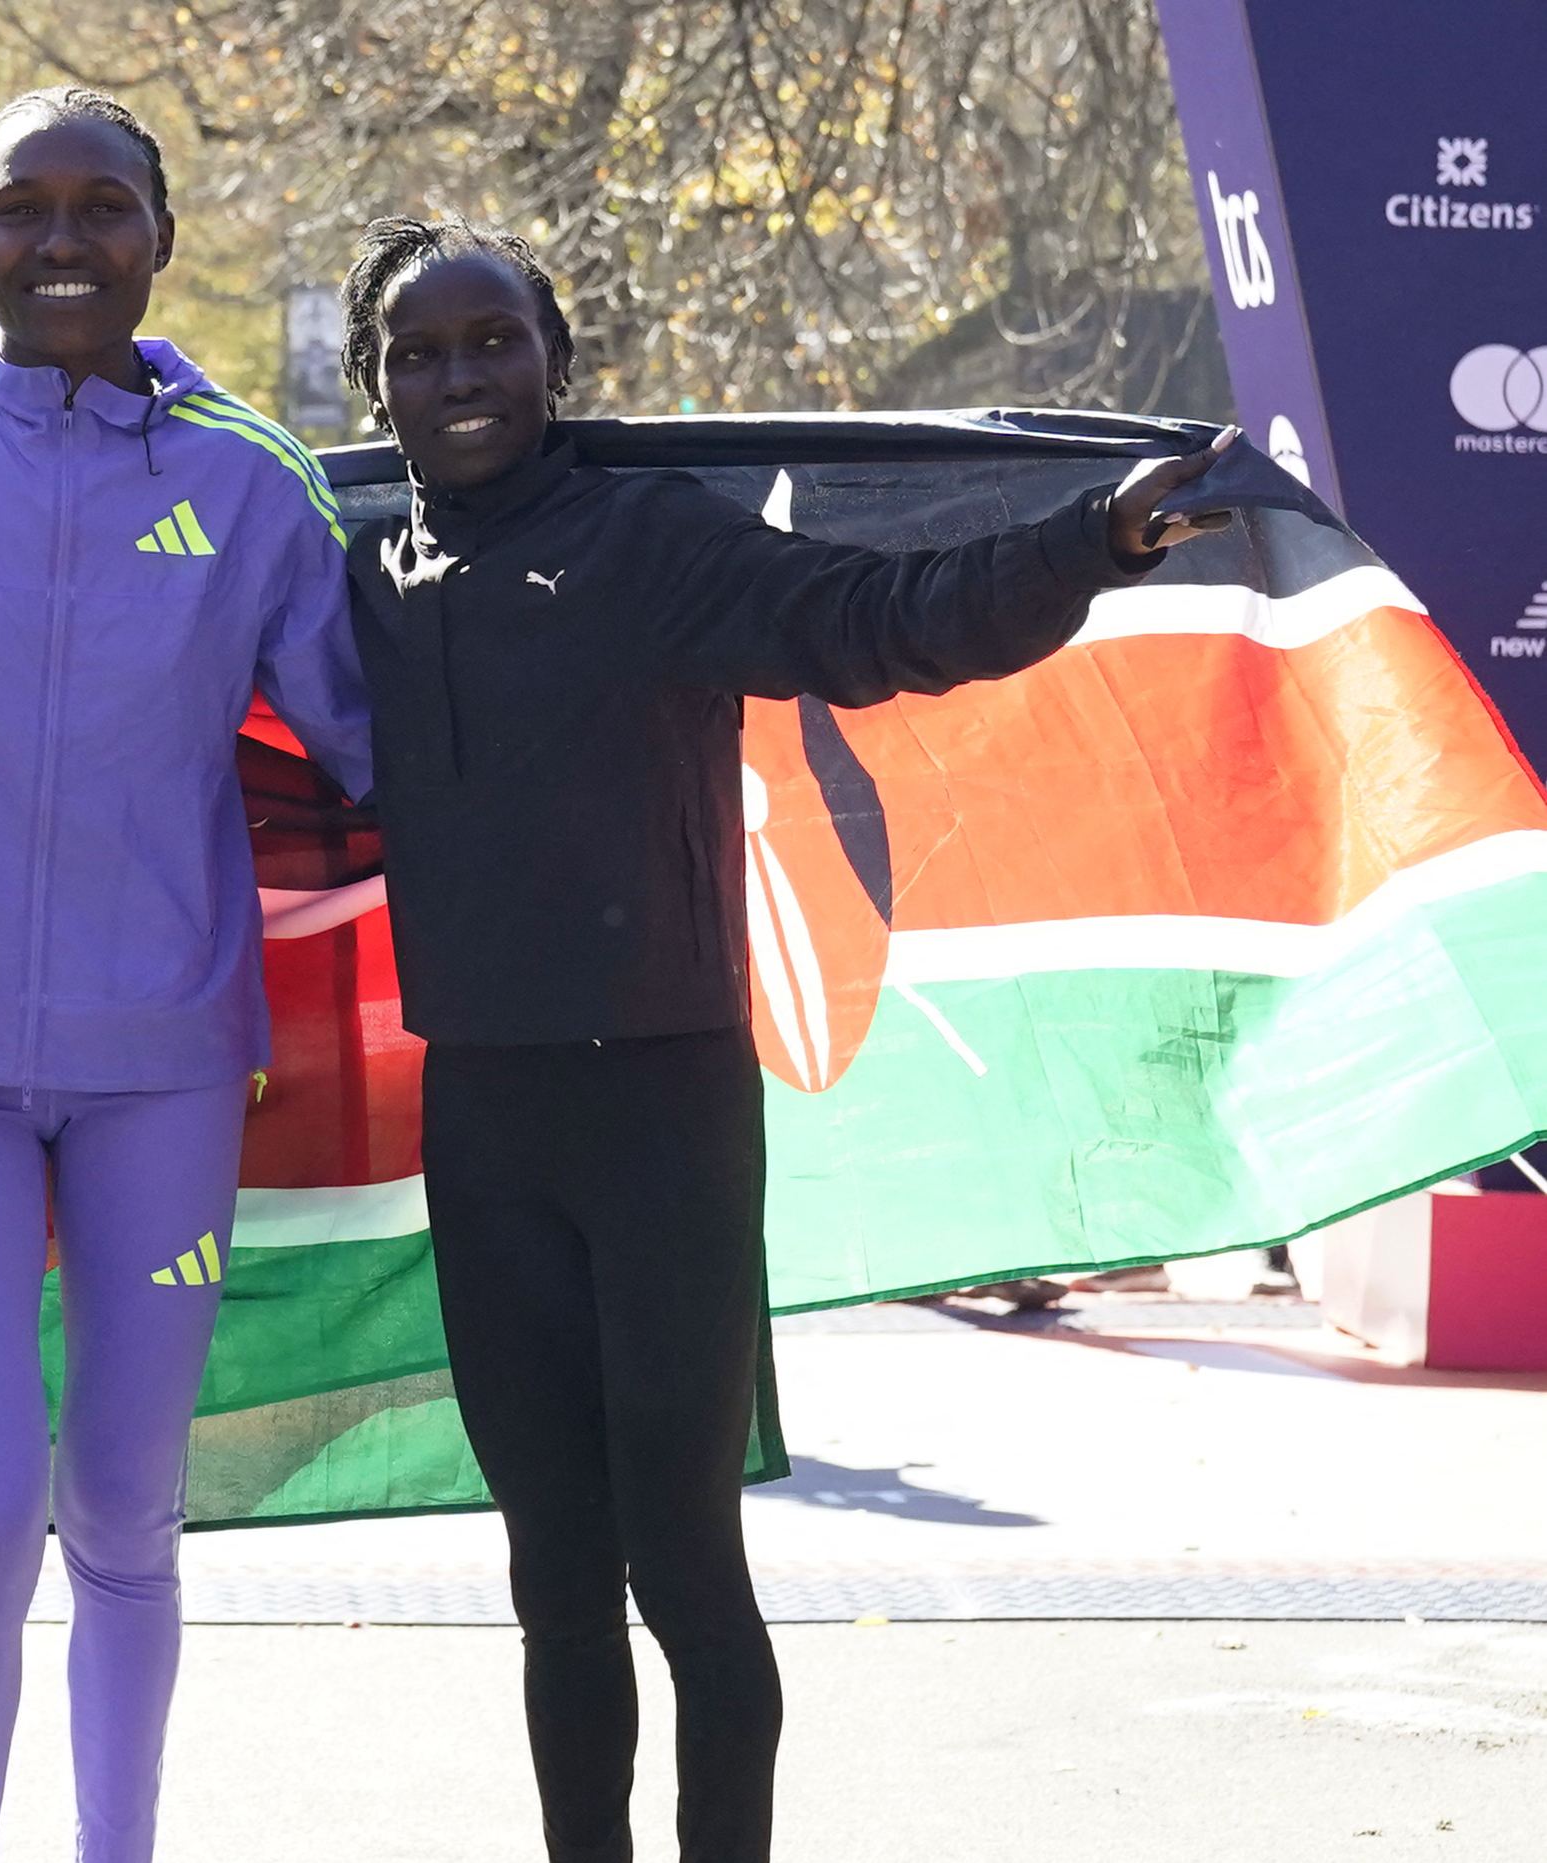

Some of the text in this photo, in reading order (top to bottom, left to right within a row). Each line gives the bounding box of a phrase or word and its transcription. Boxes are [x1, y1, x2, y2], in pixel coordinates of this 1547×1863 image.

[1385, 194, 1533, 229] Citizens
[1207, 169, 1275, 310] tcs
[1491, 636, 1546, 658] new
